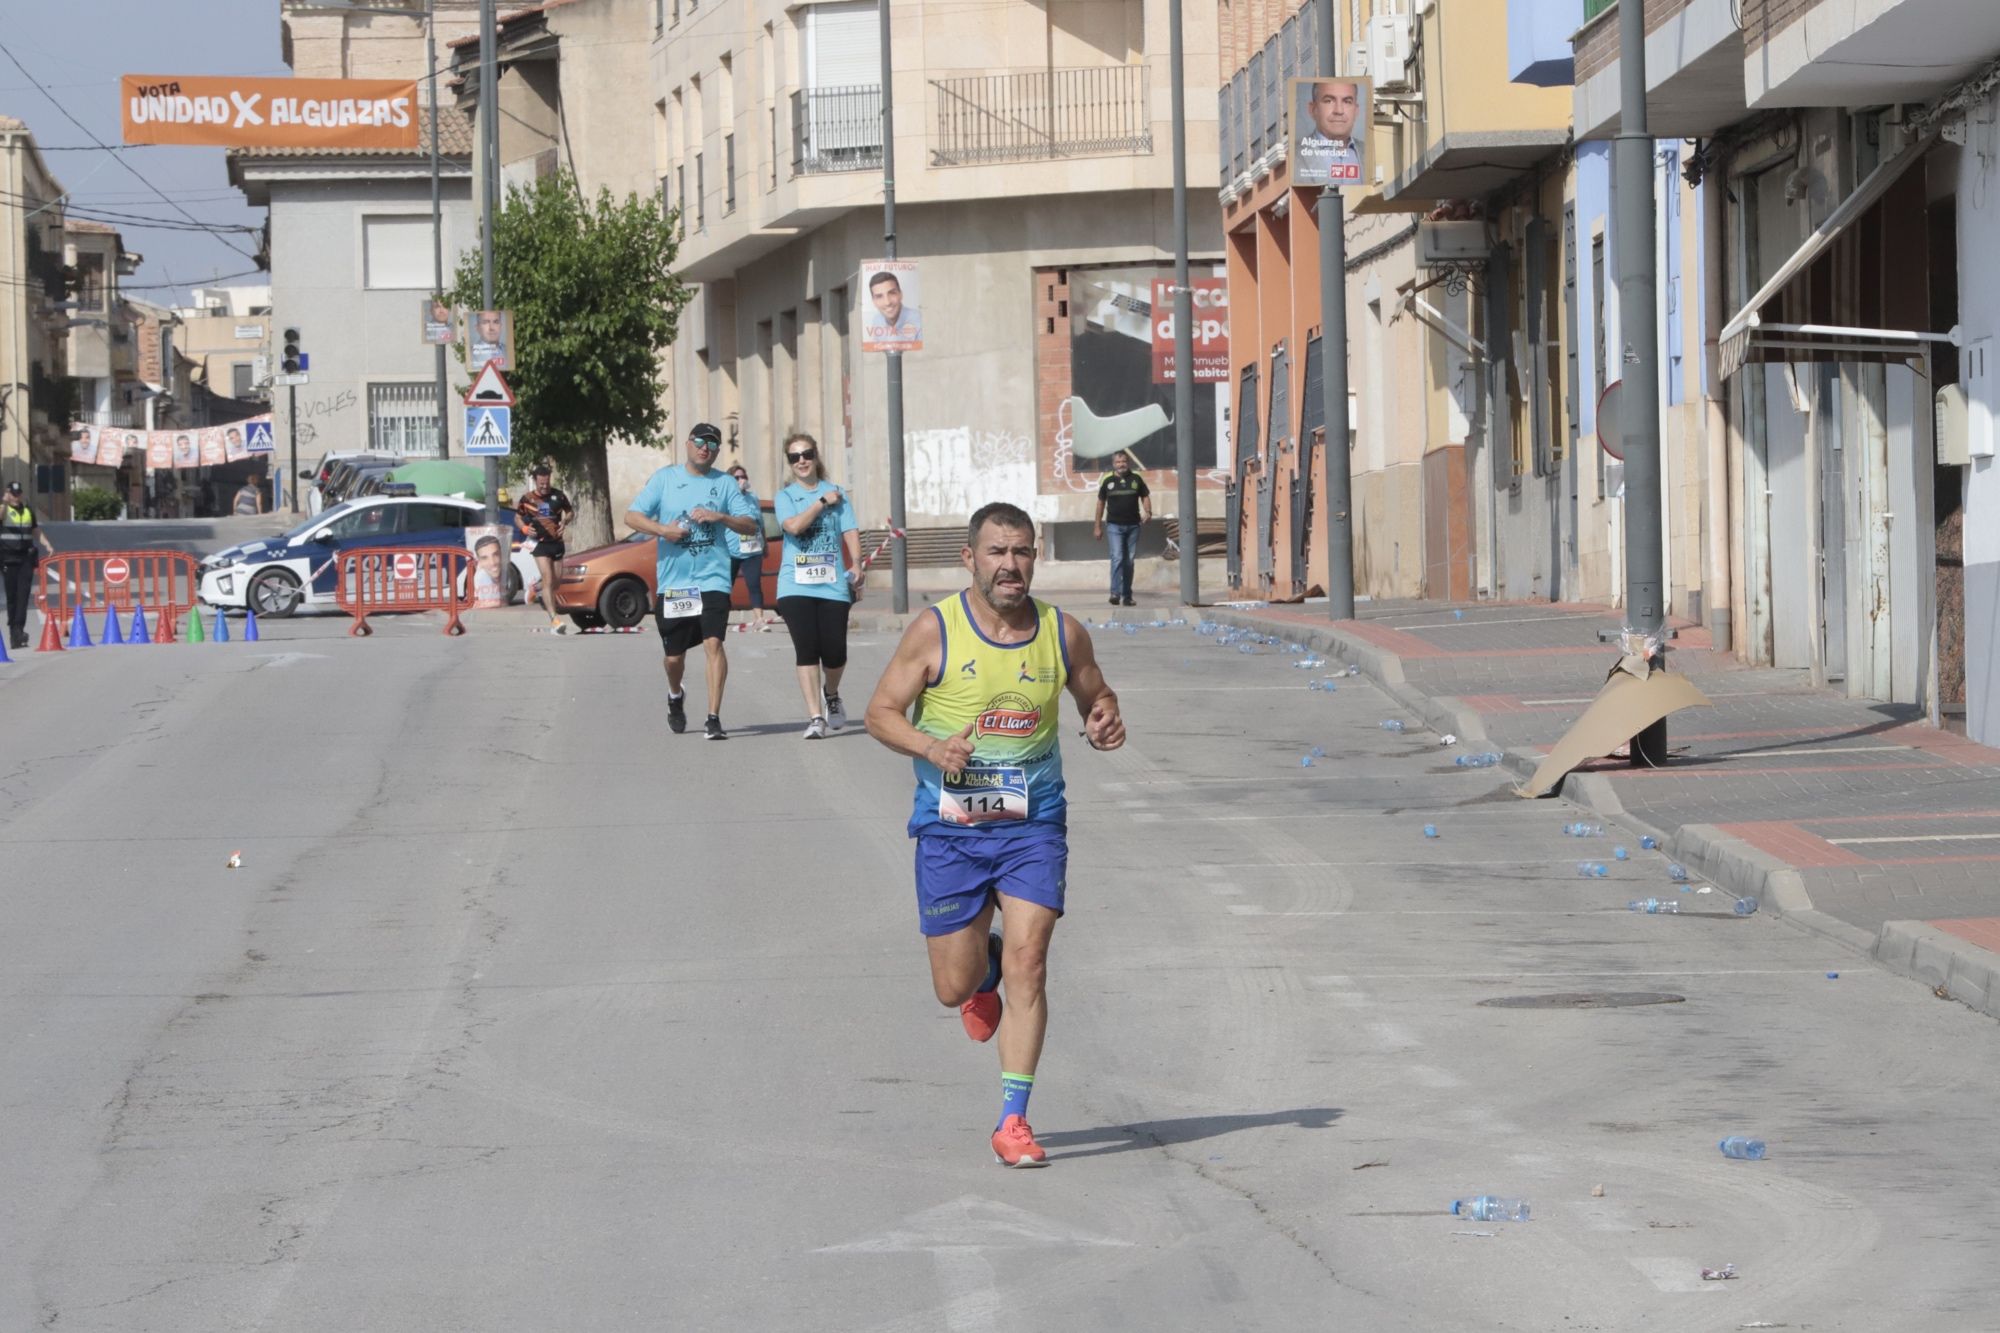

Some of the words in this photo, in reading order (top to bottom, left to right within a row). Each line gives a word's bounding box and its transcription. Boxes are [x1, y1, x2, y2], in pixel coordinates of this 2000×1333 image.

[138, 82, 180, 98] VOTA
[131, 95, 229, 123] UNIDAD
[230, 91, 264, 128] X
[270, 97, 410, 128] ALGUAZAS
[1301, 137, 1344, 147] Alguazas
[1301, 148, 1313, 156] de
[866, 326, 897, 336] VOTA
[304, 390, 357, 418] VOTES
[806, 567, 826, 576] 418
[672, 600, 692, 610] 399
[984, 715, 997, 728] El
[999, 716, 1034, 729] Llano
[965, 772, 989, 781] VILLA
[991, 774, 1004, 782] DE
[963, 796, 1006, 813] 114
